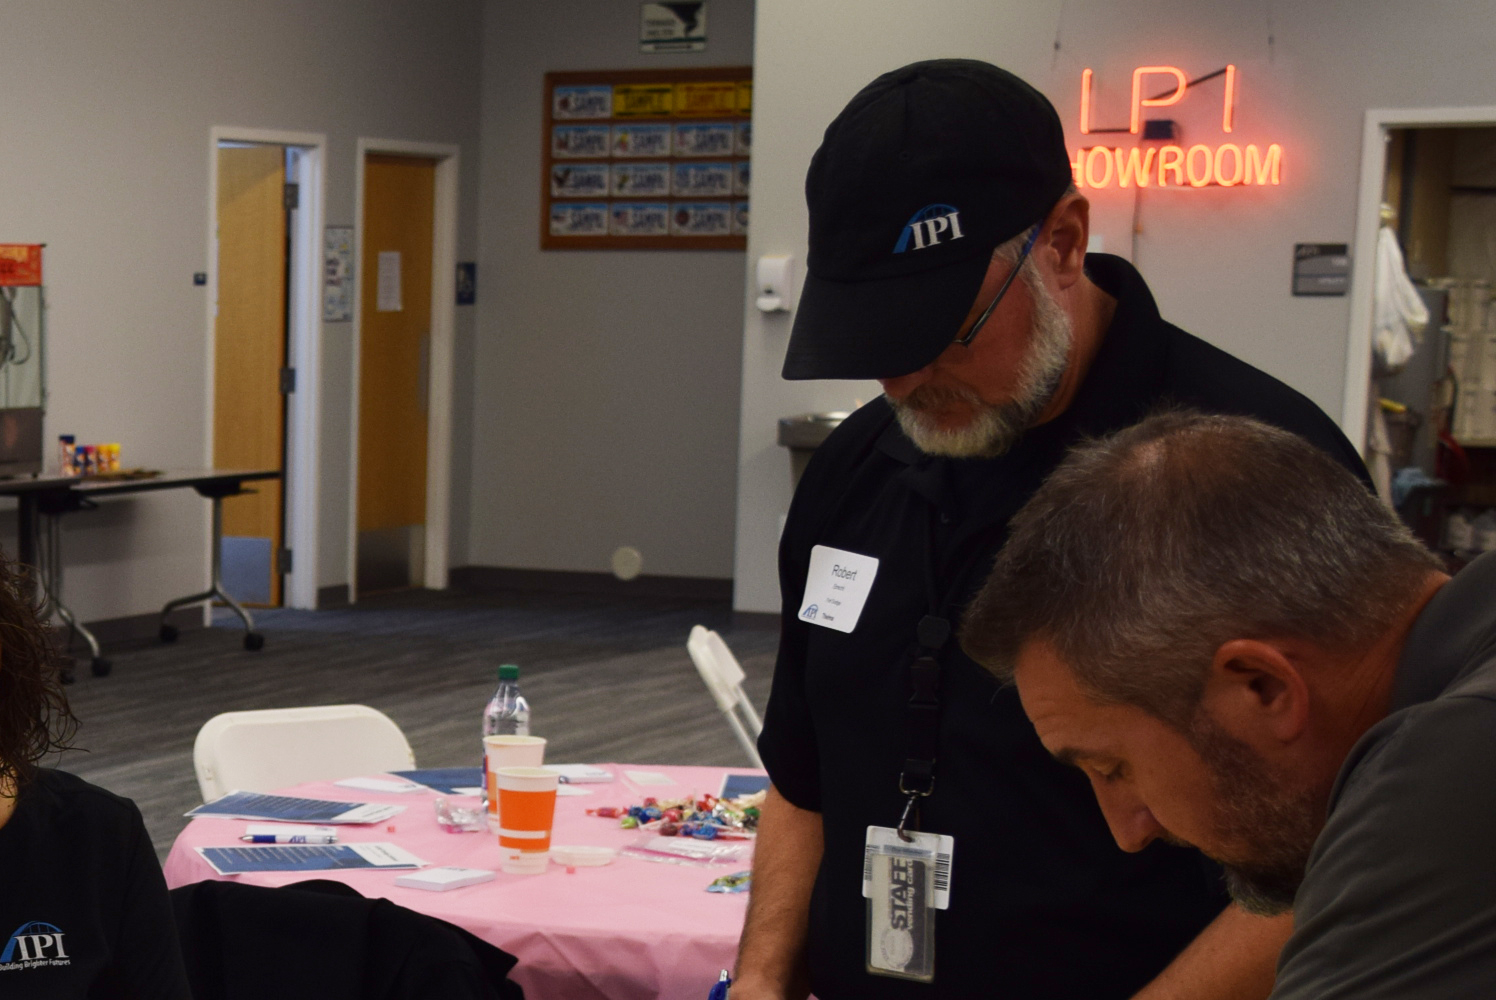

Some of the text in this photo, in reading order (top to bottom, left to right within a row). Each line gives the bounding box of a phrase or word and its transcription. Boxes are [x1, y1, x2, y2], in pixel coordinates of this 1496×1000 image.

[1070, 143, 1282, 189] HOWROOM
[909, 211, 965, 251] IPI
[831, 564, 858, 581] Robert
[14, 933, 70, 961] IPI
[24, 959, 49, 969] Brighter
[49, 958, 71, 966] Futures
